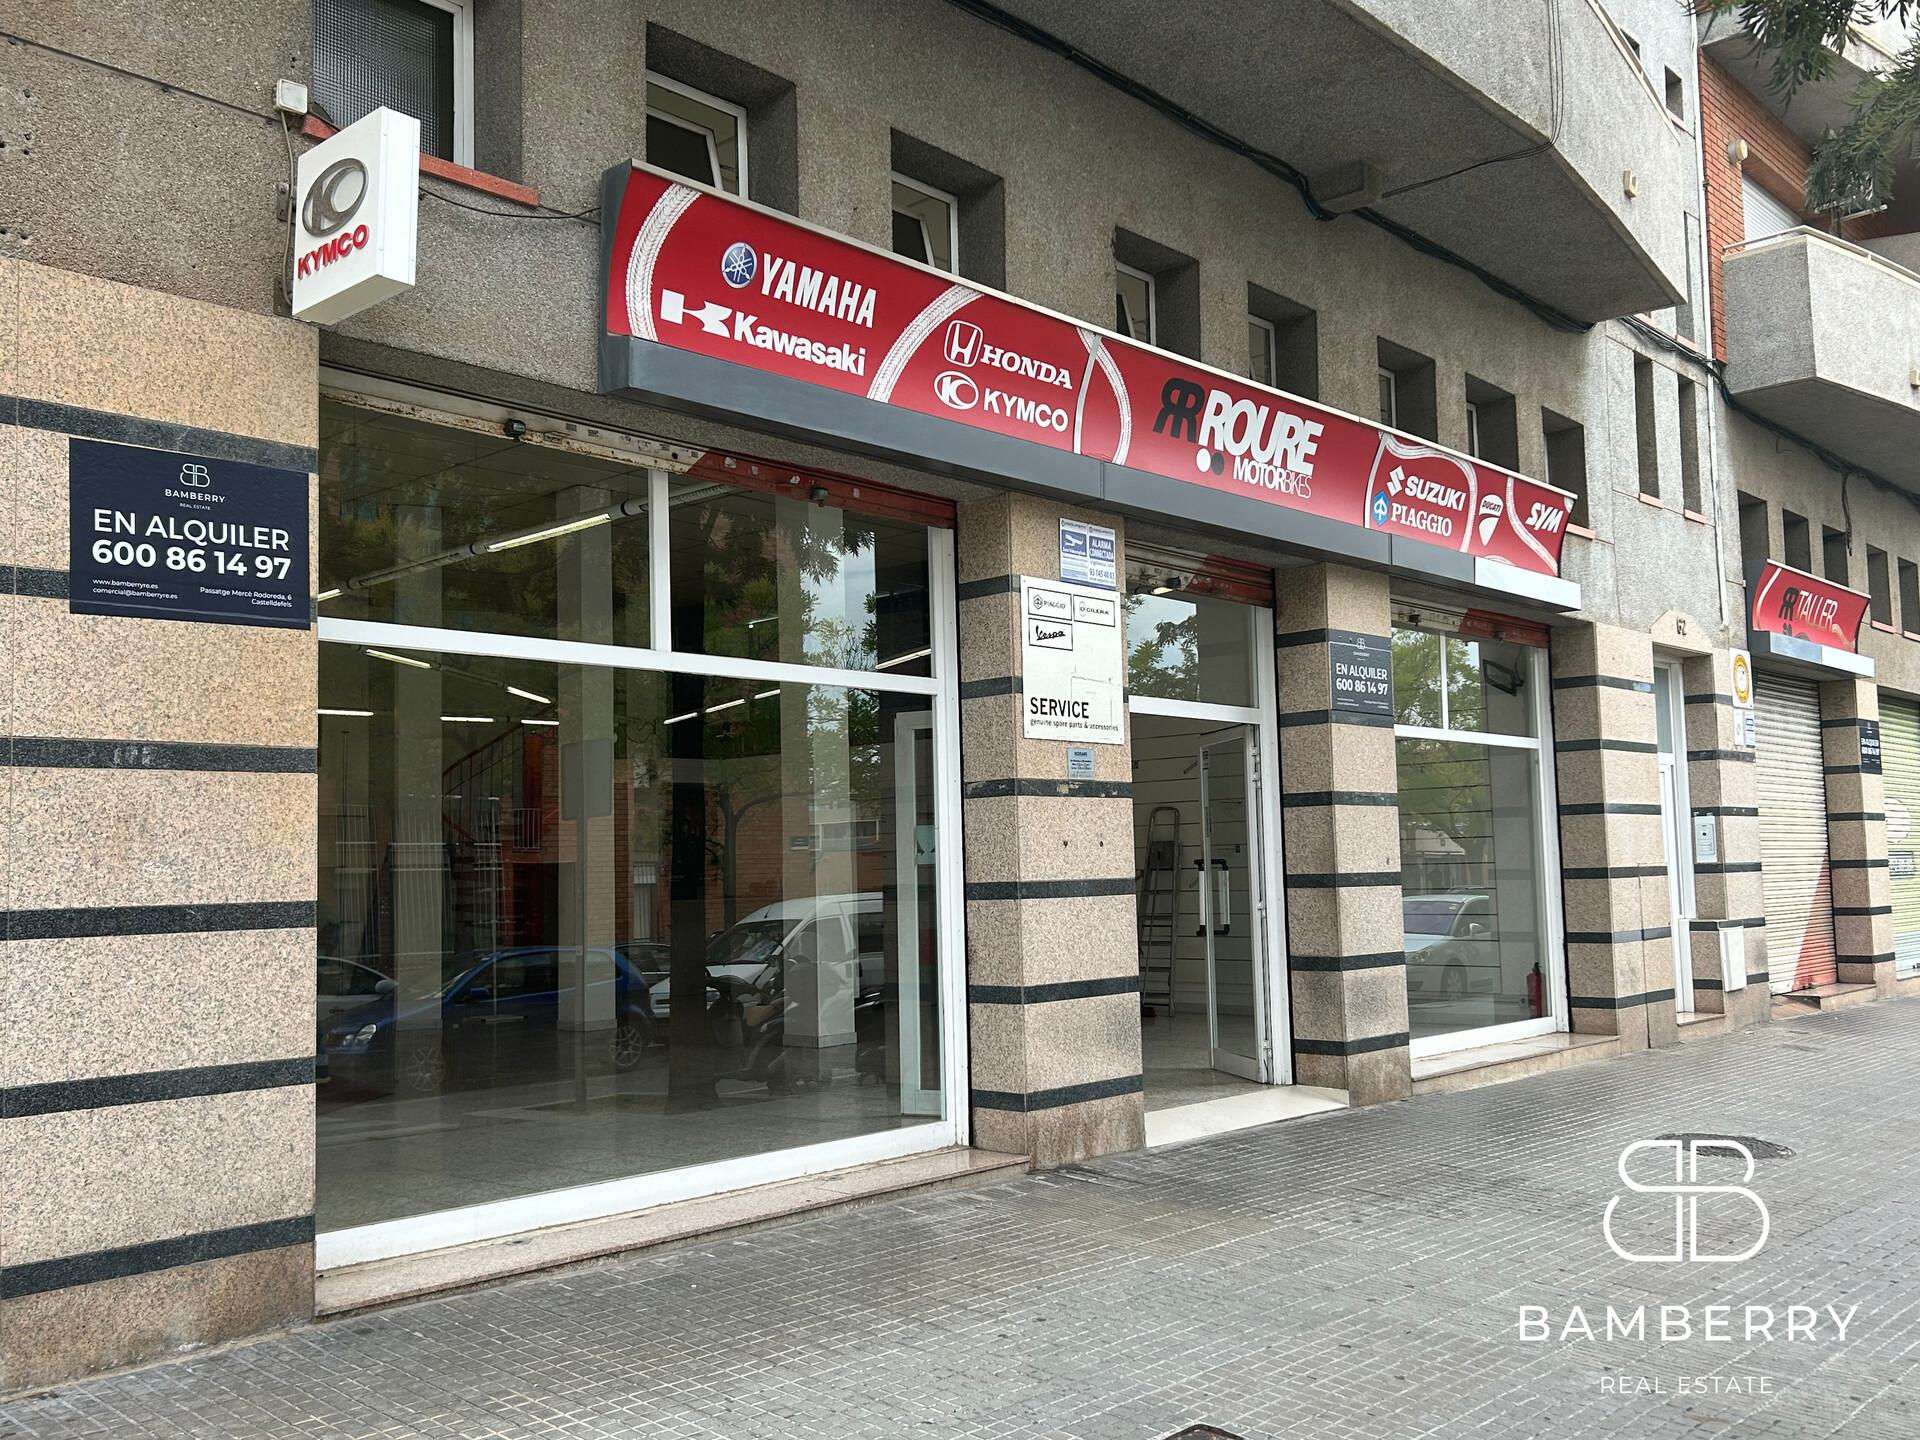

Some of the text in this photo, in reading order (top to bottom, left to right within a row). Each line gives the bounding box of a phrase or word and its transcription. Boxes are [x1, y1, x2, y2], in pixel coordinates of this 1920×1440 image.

[297, 224, 370, 280] KYMCO
[761, 252, 878, 329] YAMAHA
[733, 311, 866, 376] Kawasaki
[980, 343, 1073, 390] HONDA
[983, 387, 1069, 432] KYMCO
[1198, 389, 1325, 476] ROURE
[165, 488, 226, 503] BAMBERRY
[1232, 455, 1312, 499] MOTORBIKES
[1404, 475, 1467, 512] SUZUKI
[94, 508, 290, 551] EN ALQUILER
[1390, 502, 1453, 537] PIAGGIO
[1525, 502, 1564, 533] SYM
[92, 539, 292, 580] 600 86 14 97
[200, 586, 231, 597] Passatge
[1035, 624, 1066, 641] Vespa
[1336, 662, 1388, 681] EN ALQUILER
[1336, 677, 1389, 696] 600 86 14 97
[1030, 696, 1090, 719] SERVICE
[1030, 718, 1052, 727] genuine
[1053, 720, 1068, 728] spare
[1069, 721, 1083, 729] parts
[1089, 723, 1119, 732] accessories
